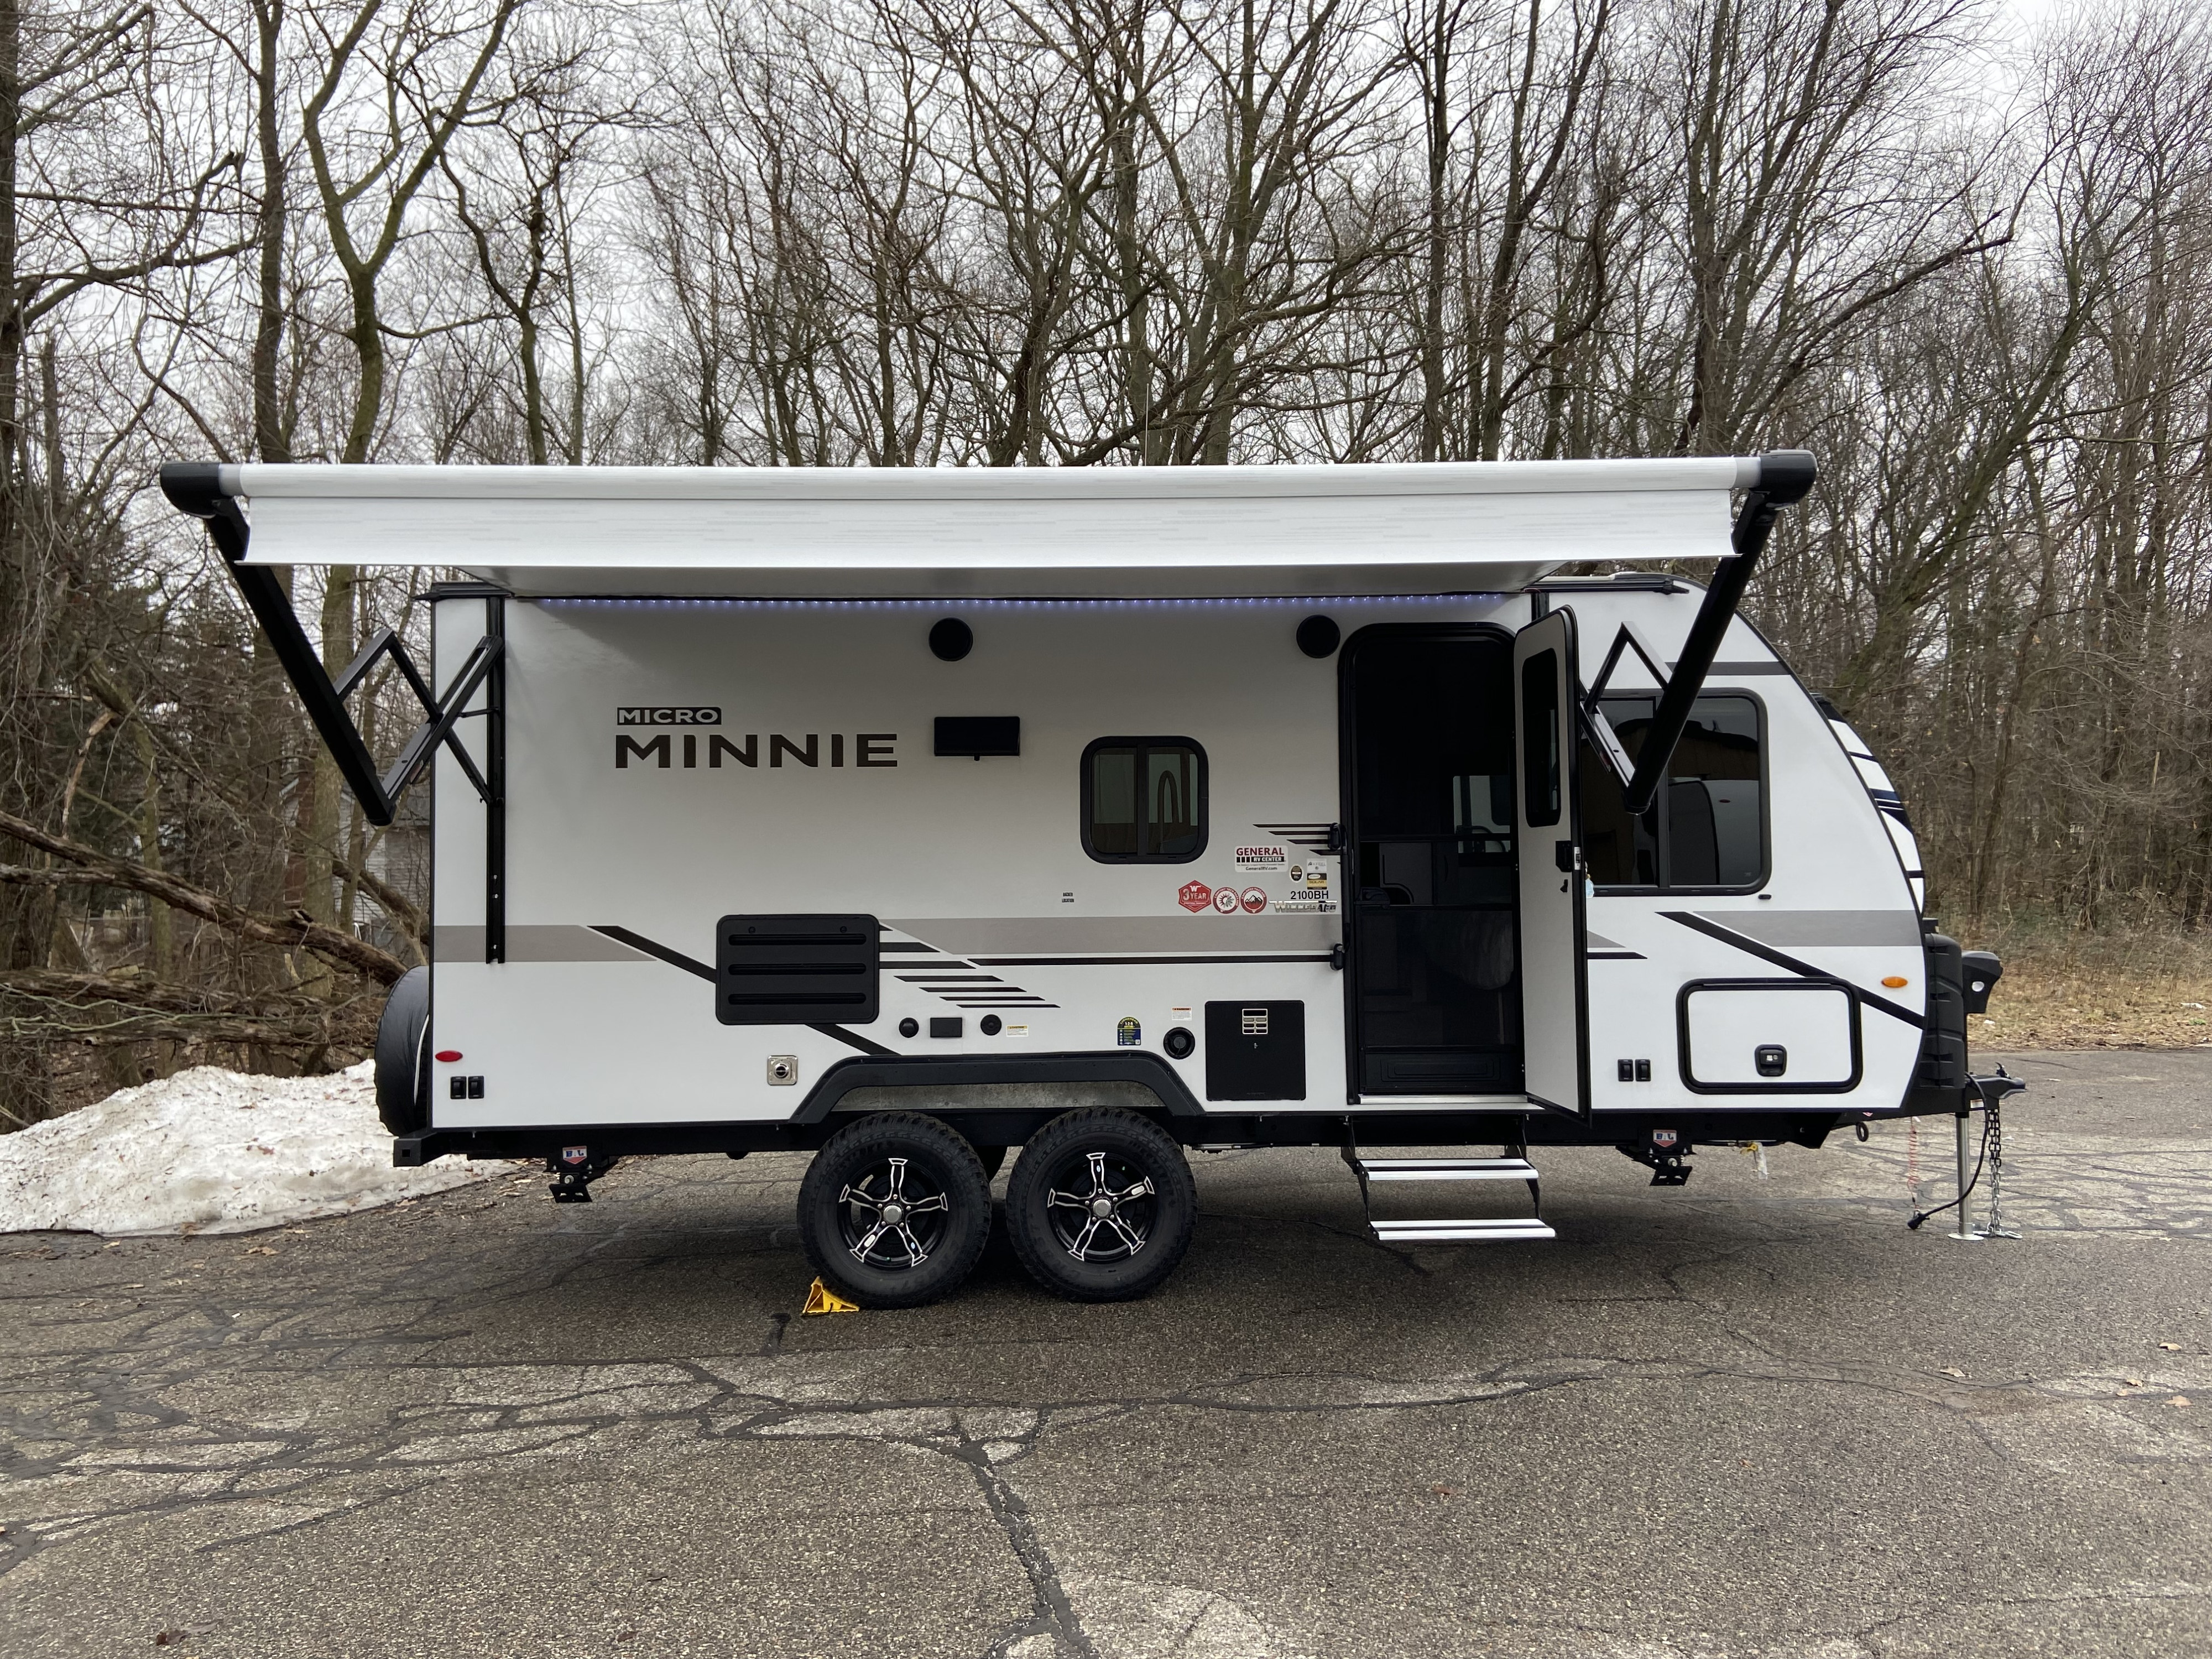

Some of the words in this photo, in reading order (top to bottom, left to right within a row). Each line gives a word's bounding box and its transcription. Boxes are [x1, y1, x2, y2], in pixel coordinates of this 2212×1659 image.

[619, 709, 718, 723] MICRO
[615, 734, 898, 768] MINNIE
[1236, 847, 1284, 855] GENERAL
[1183, 889, 1189, 900] 3
[1290, 890, 1329, 899] 2100BH
